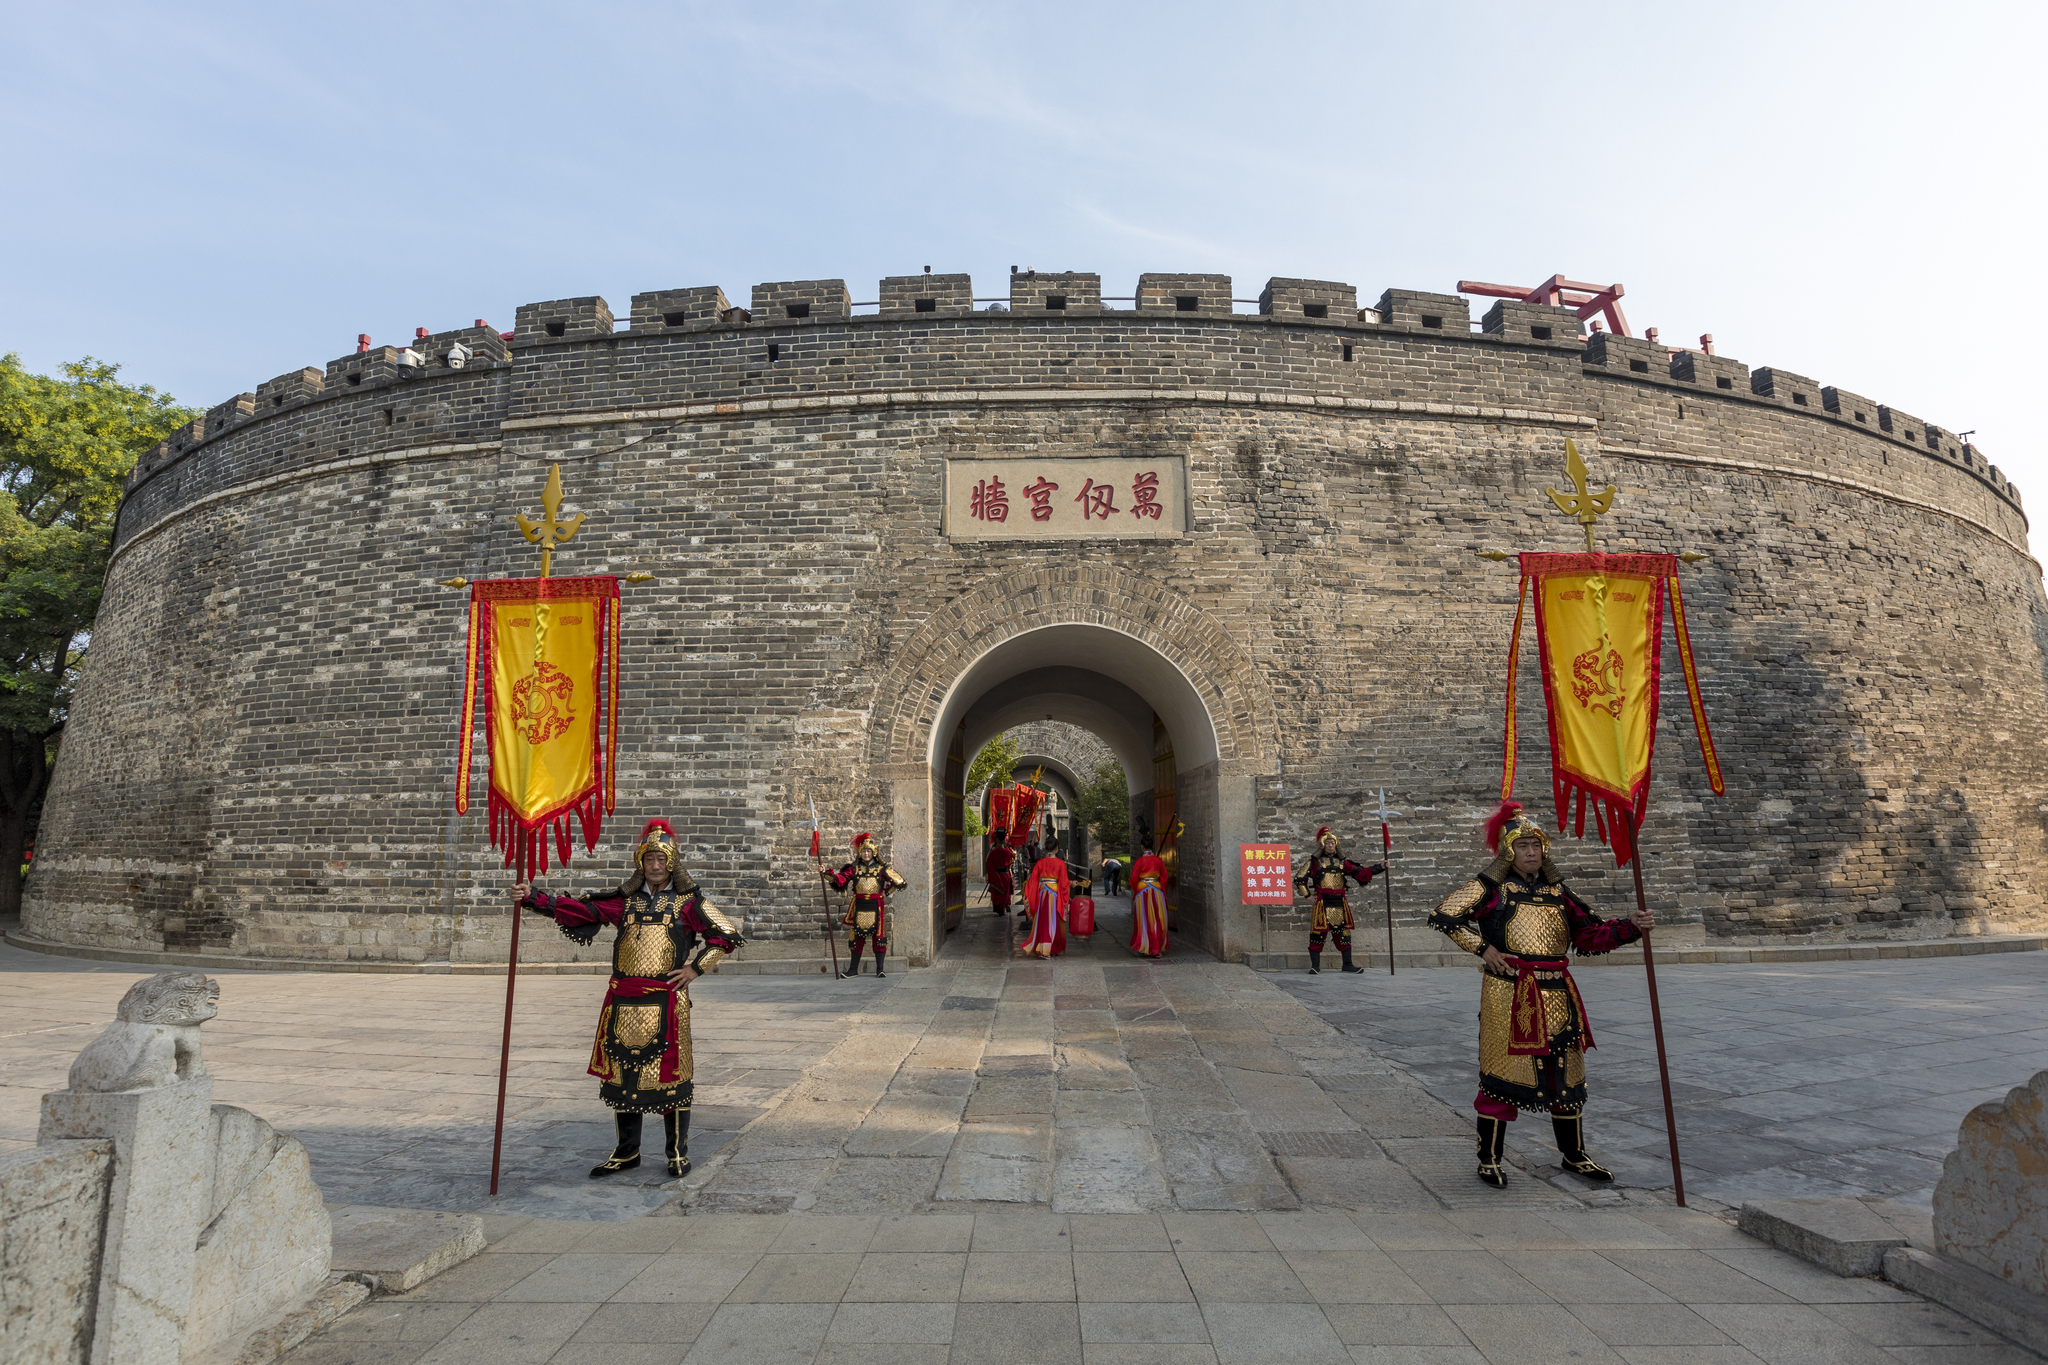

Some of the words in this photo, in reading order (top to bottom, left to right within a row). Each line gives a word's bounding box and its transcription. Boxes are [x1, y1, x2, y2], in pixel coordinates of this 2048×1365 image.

[1244, 849, 1286, 860] 售票大厅
[1246, 865, 1286, 875] 免费人群
[1246, 878, 1286, 888] 换票处
